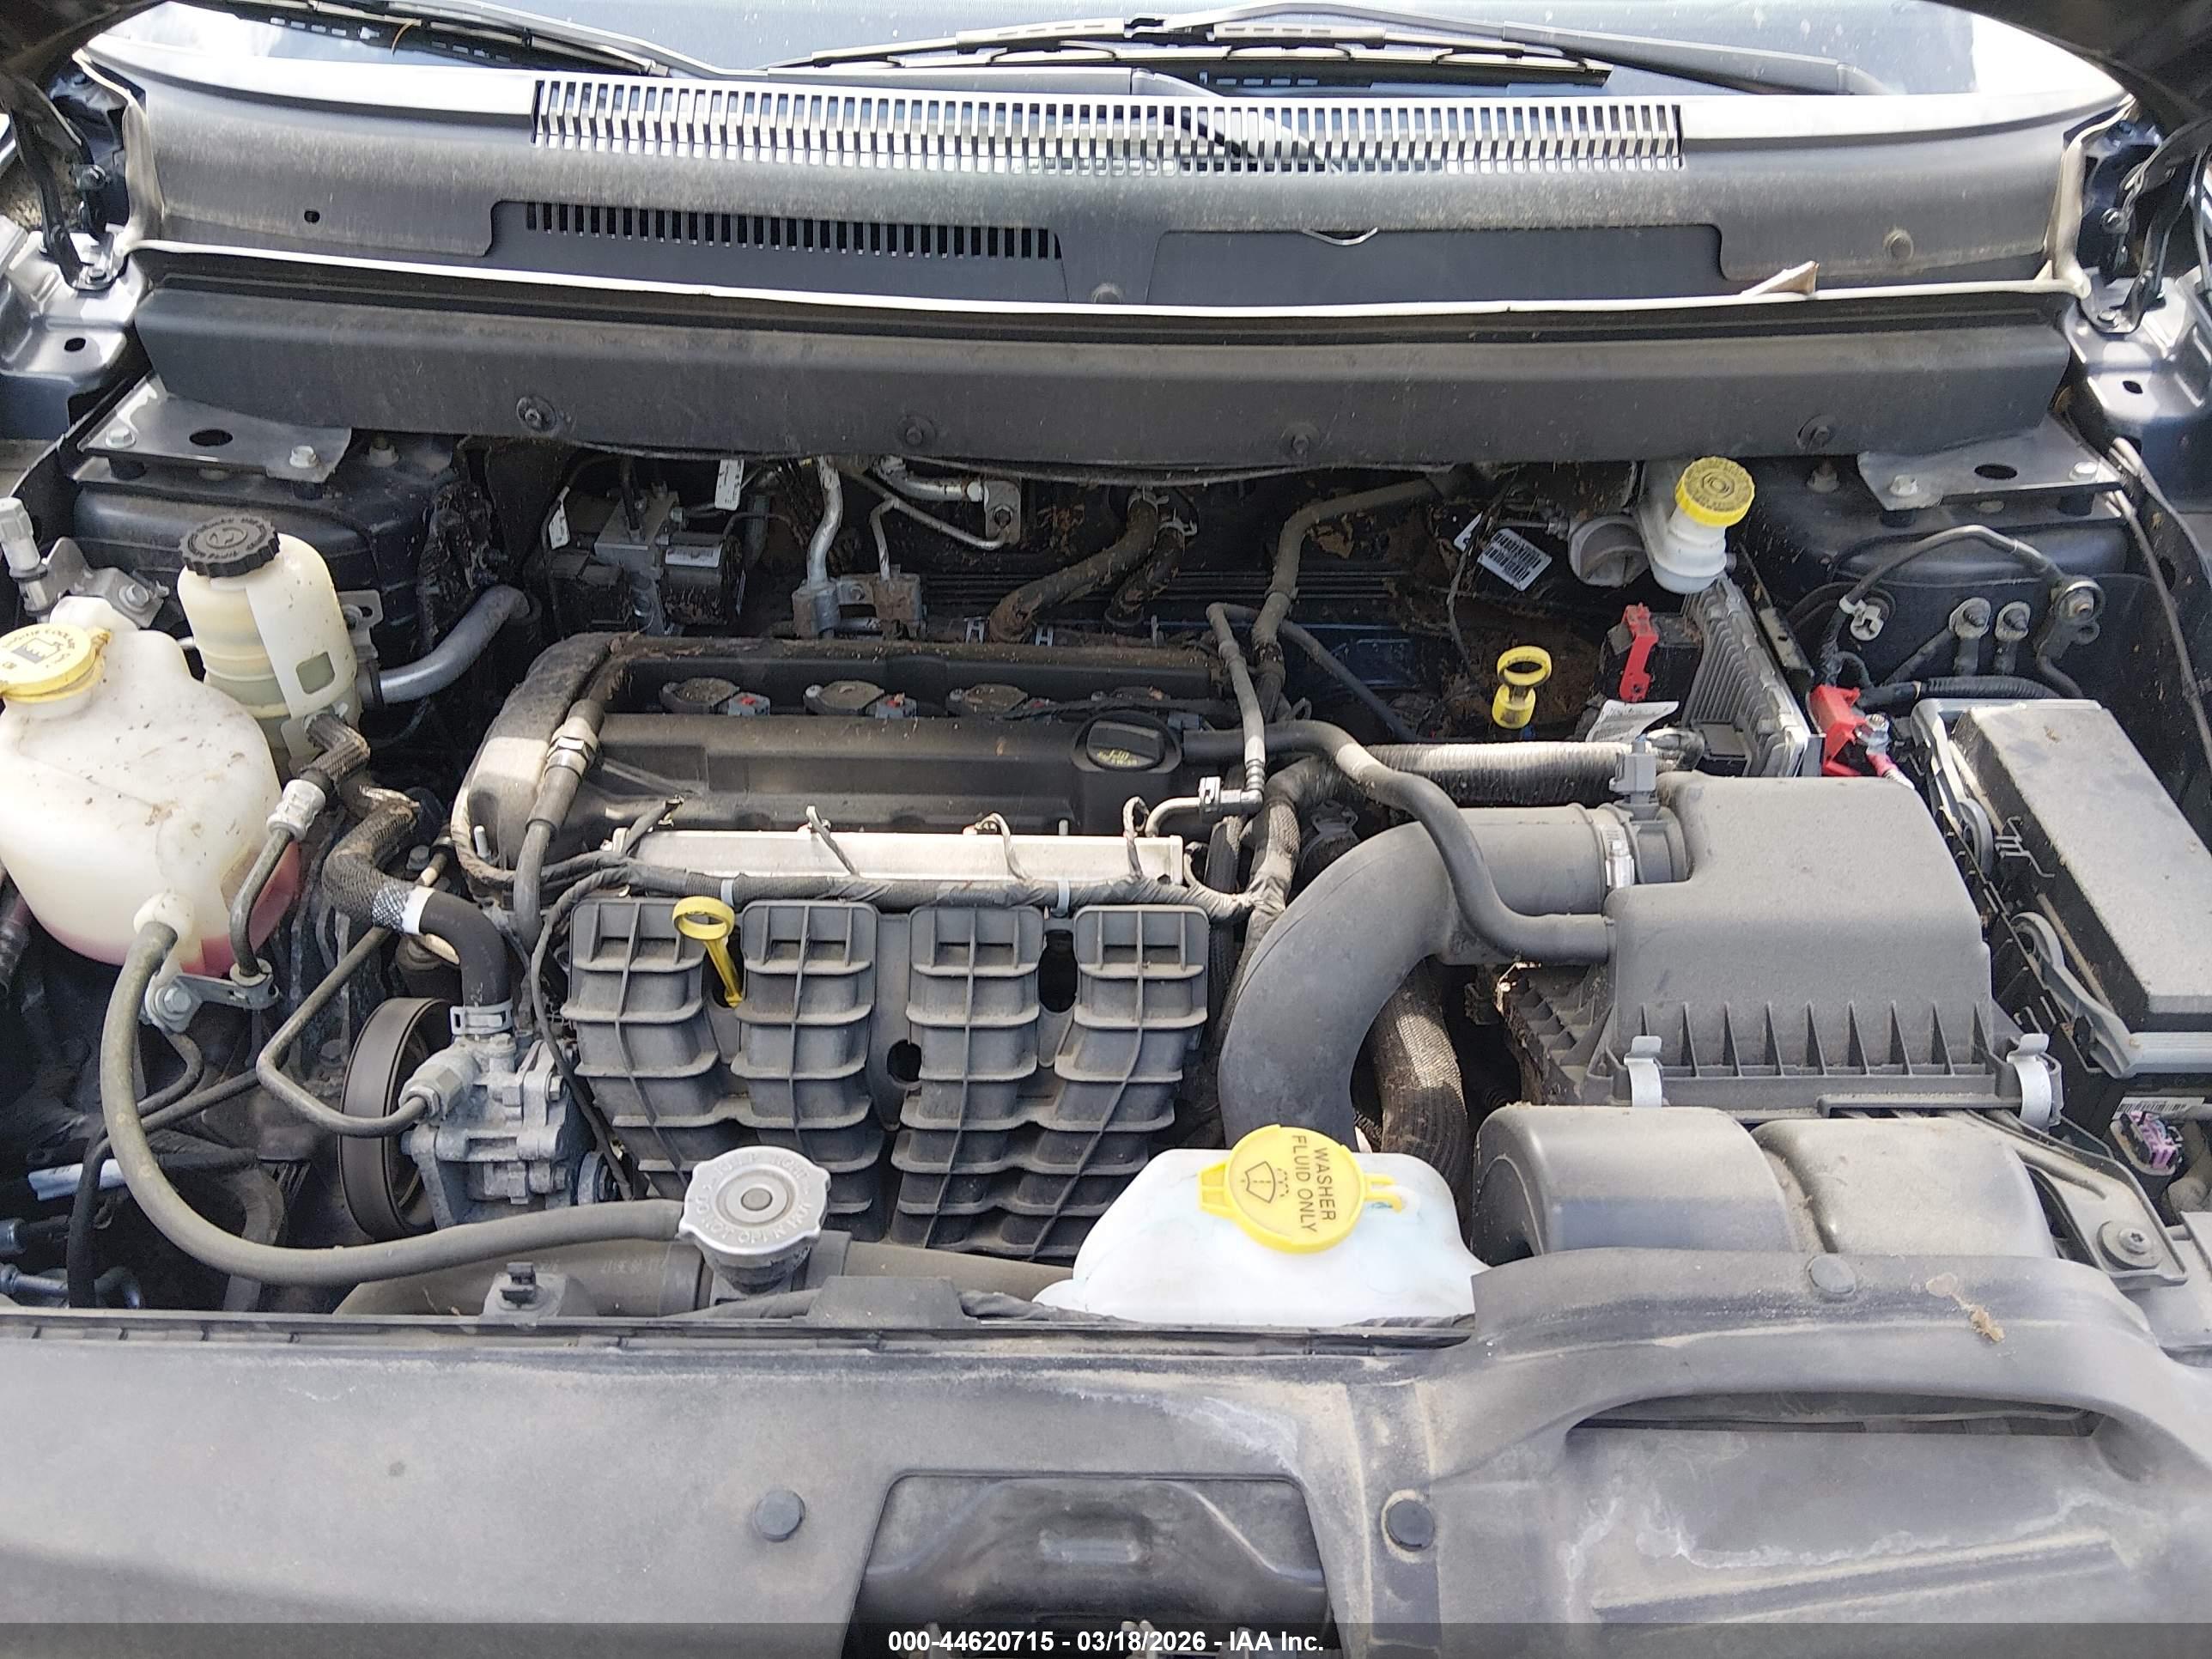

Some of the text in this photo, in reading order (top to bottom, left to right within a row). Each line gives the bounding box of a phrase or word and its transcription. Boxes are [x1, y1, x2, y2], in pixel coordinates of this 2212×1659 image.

[1291, 1135, 1317, 1233] FLUID ONLY
[1314, 1147, 1336, 1221] WASHER
